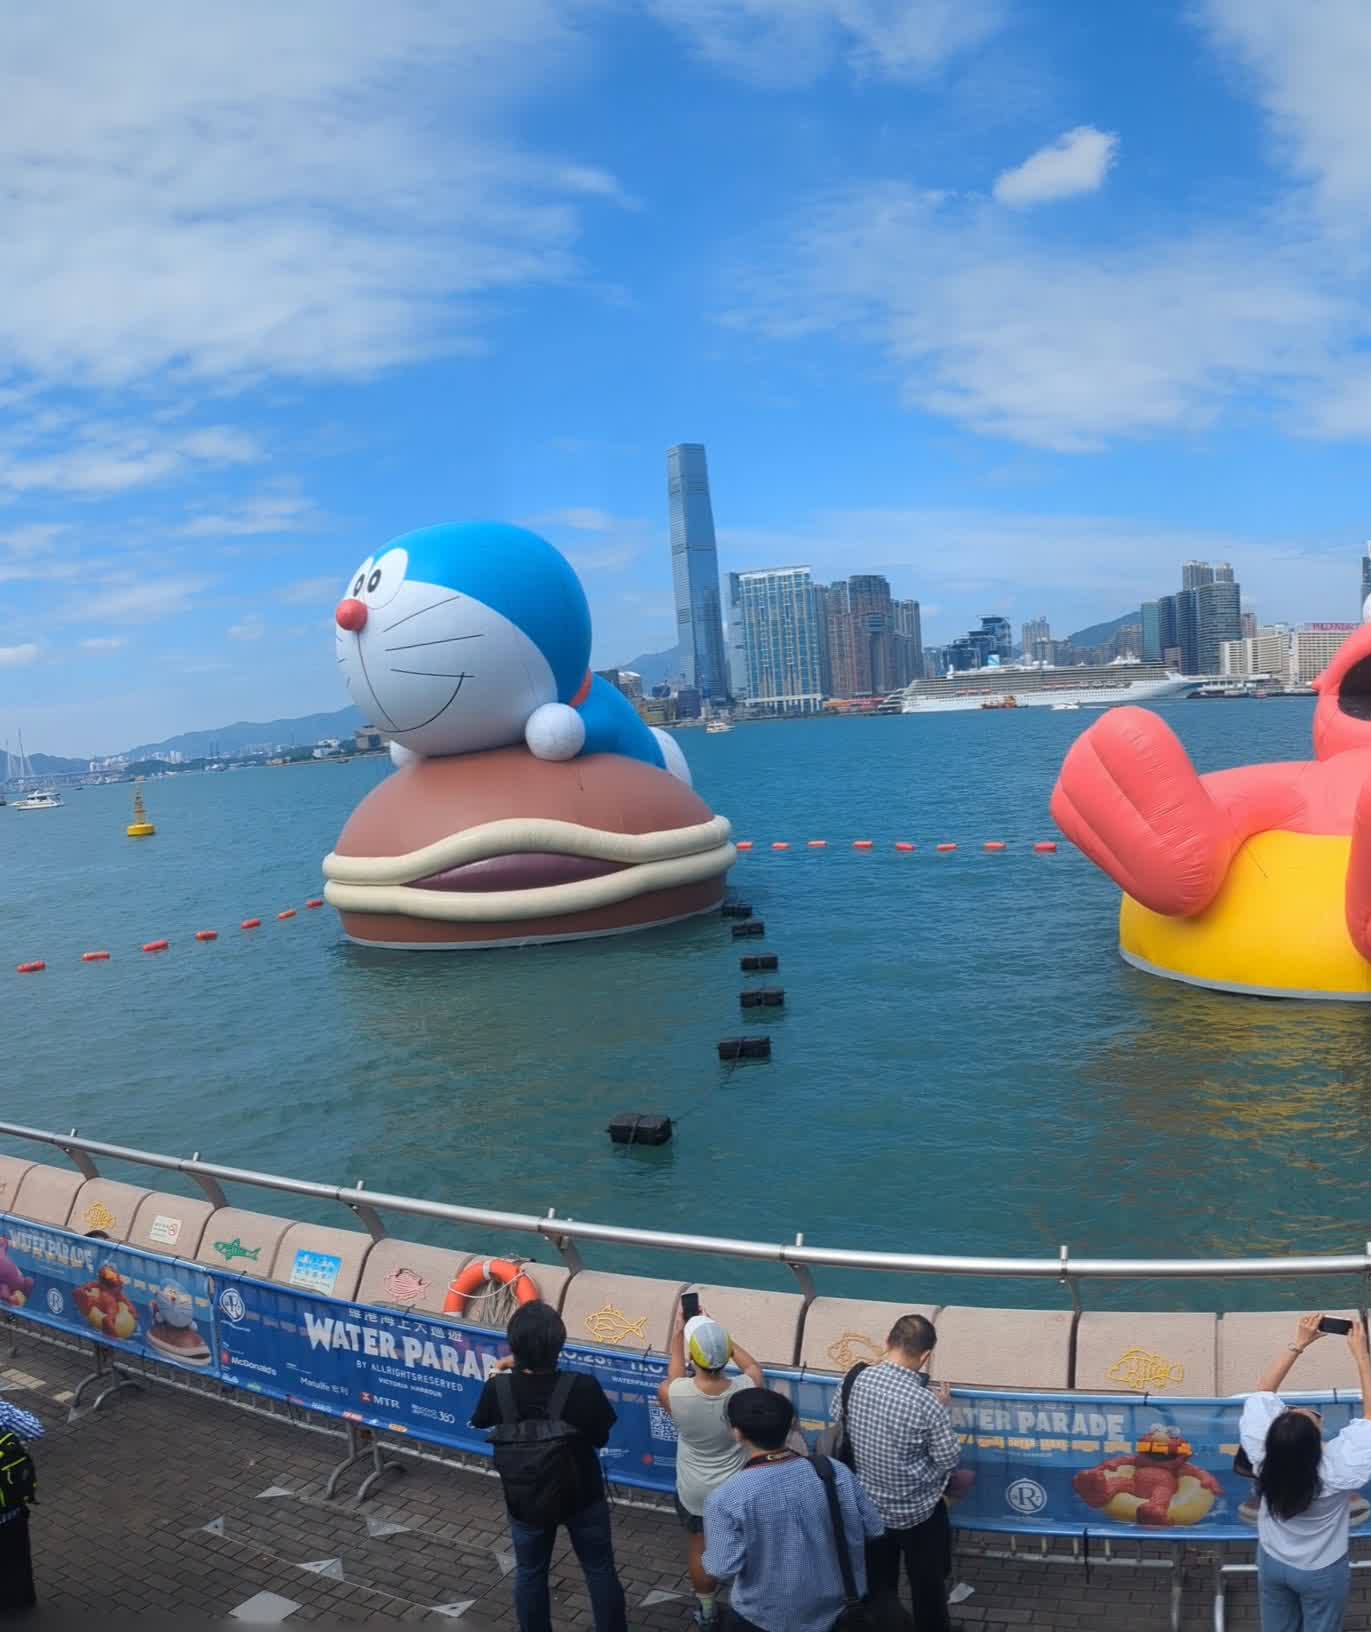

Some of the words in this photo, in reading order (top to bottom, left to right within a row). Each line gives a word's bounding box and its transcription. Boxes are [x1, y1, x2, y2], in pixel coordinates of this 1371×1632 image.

[47, 1239, 95, 1273] PARADE
[304, 1312, 399, 1361] WATER
[402, 1336, 499, 1383] PARAD
[300, 1376, 331, 1392] Manulife
[356, 1359, 367, 1369] BY
[371, 1364, 464, 1392] ALLRIGHTSRESERVED
[373, 1395, 400, 1409] MTR
[951, 1407, 1011, 1430] ATER
[1018, 1411, 1125, 1441] PARADE
